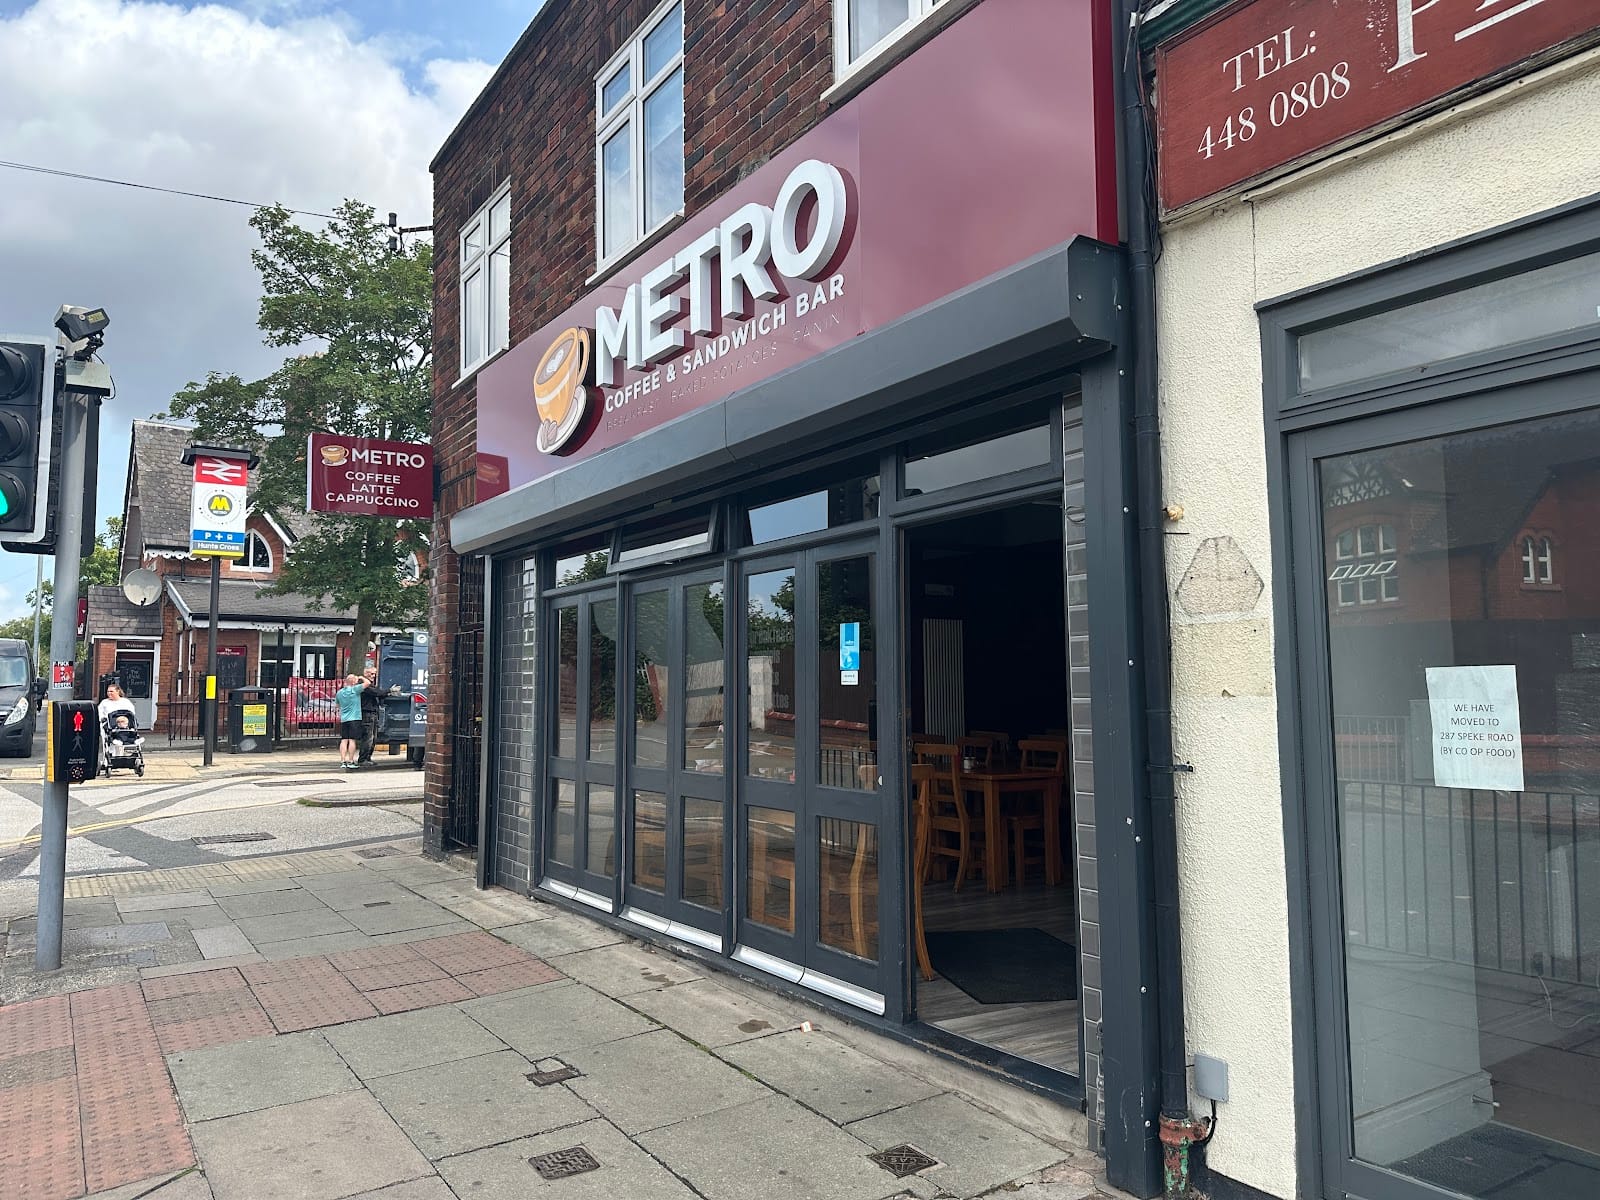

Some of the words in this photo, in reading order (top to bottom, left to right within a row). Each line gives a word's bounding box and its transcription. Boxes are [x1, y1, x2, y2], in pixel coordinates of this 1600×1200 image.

[1222, 25, 1317, 93] TEL:
[1197, 106, 1257, 160] 448
[1269, 61, 1351, 128] 0808
[595, 159, 847, 388] METRO
[605, 370, 661, 413] COFFEE
[665, 363, 677, 383] &
[682, 303, 787, 375] SANDWICH
[795, 274, 845, 318] BAR
[351, 447, 425, 469] METRO
[345, 470, 401, 485] COFFEE
[351, 482, 395, 495] LATTE
[325, 492, 419, 508] CAPPUCCINO
[1453, 704, 1468, 712] WE
[1471, 704, 1495, 713] HAVE
[1450, 717, 1485, 726] MOVED
[1487, 718, 1500, 727] TO
[1440, 732, 1455, 740] 287
[1457, 732, 1484, 741] SPEKE
[1487, 733, 1514, 742] ROAD
[1440, 746, 1453, 756] (BY
[1455, 747, 1468, 756] CO
[1470, 747, 1483, 756] OP
[1486, 748, 1516, 759] FOOD)
